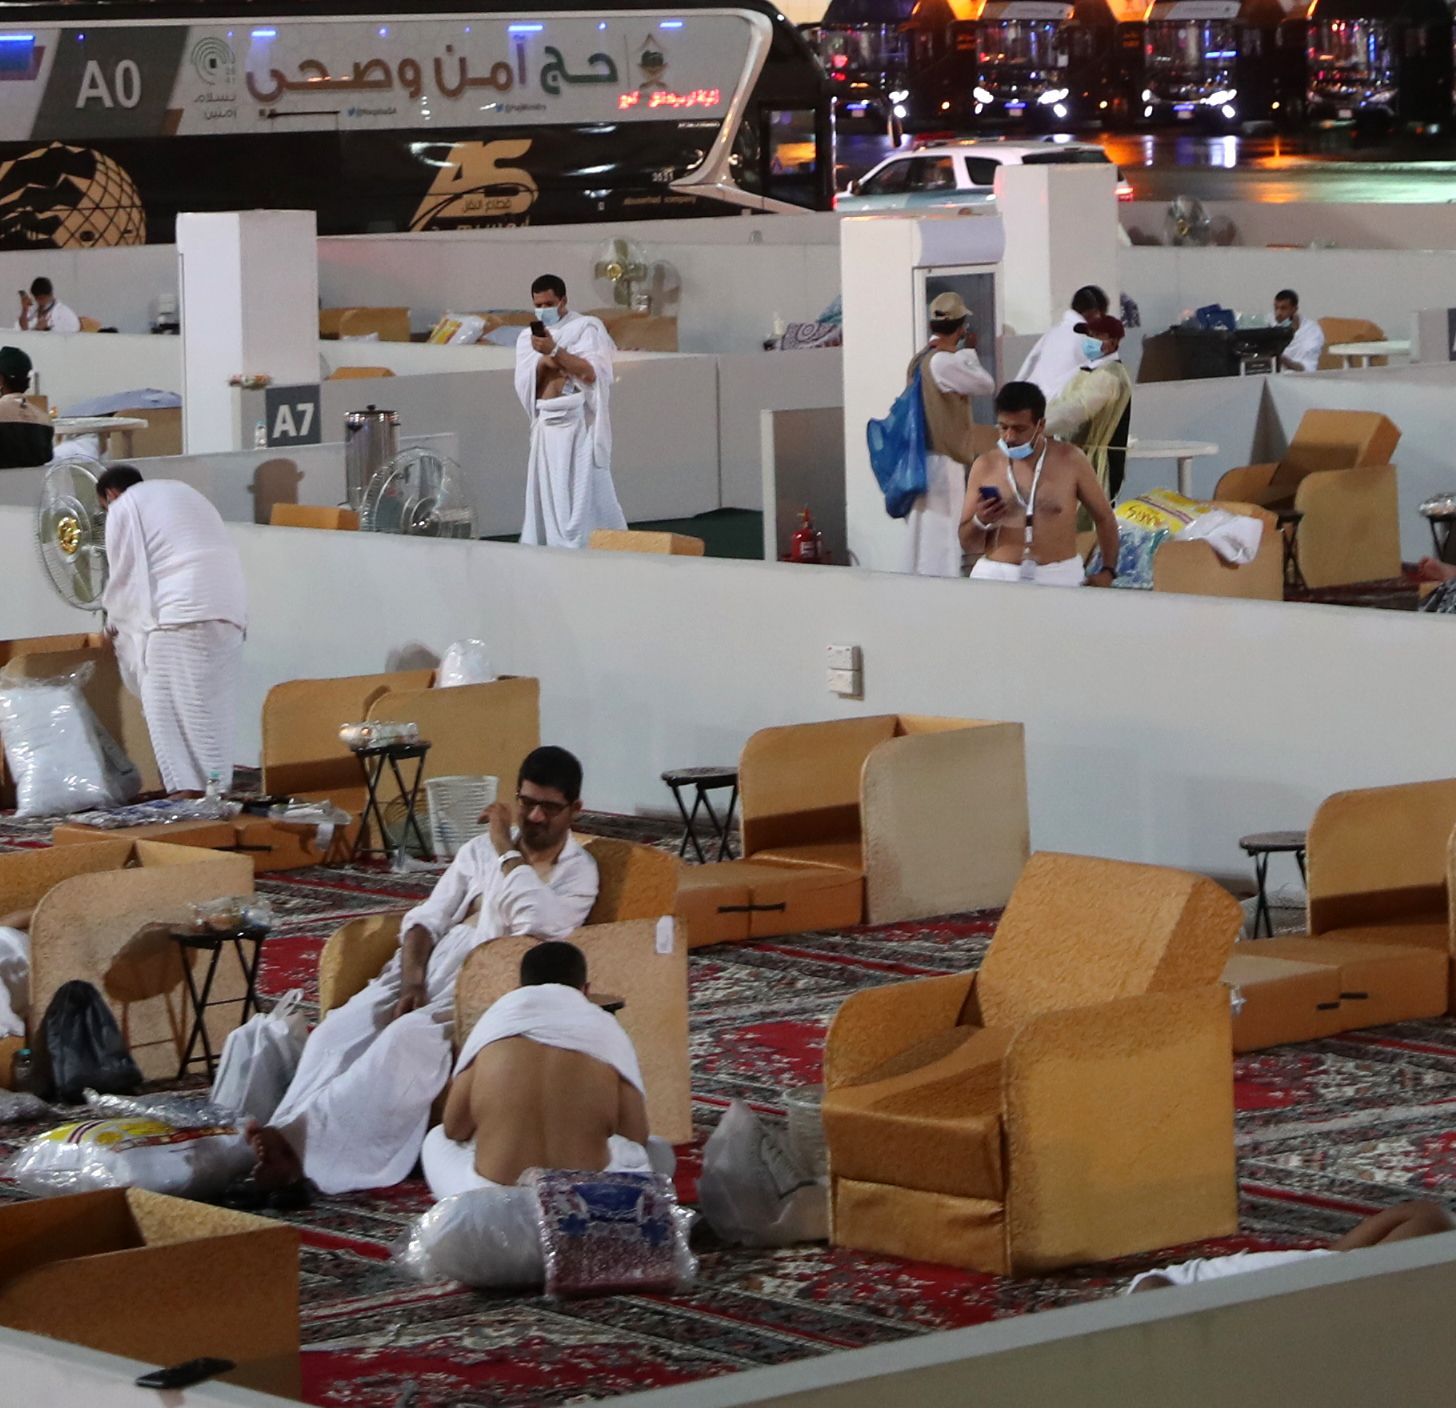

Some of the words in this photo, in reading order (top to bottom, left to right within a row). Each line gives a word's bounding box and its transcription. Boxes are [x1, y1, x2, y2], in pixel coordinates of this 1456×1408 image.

[75, 58, 142, 109] A0
[246, 55, 423, 101] وصحي
[540, 45, 619, 95] حج
[272, 402, 315, 439] A7
